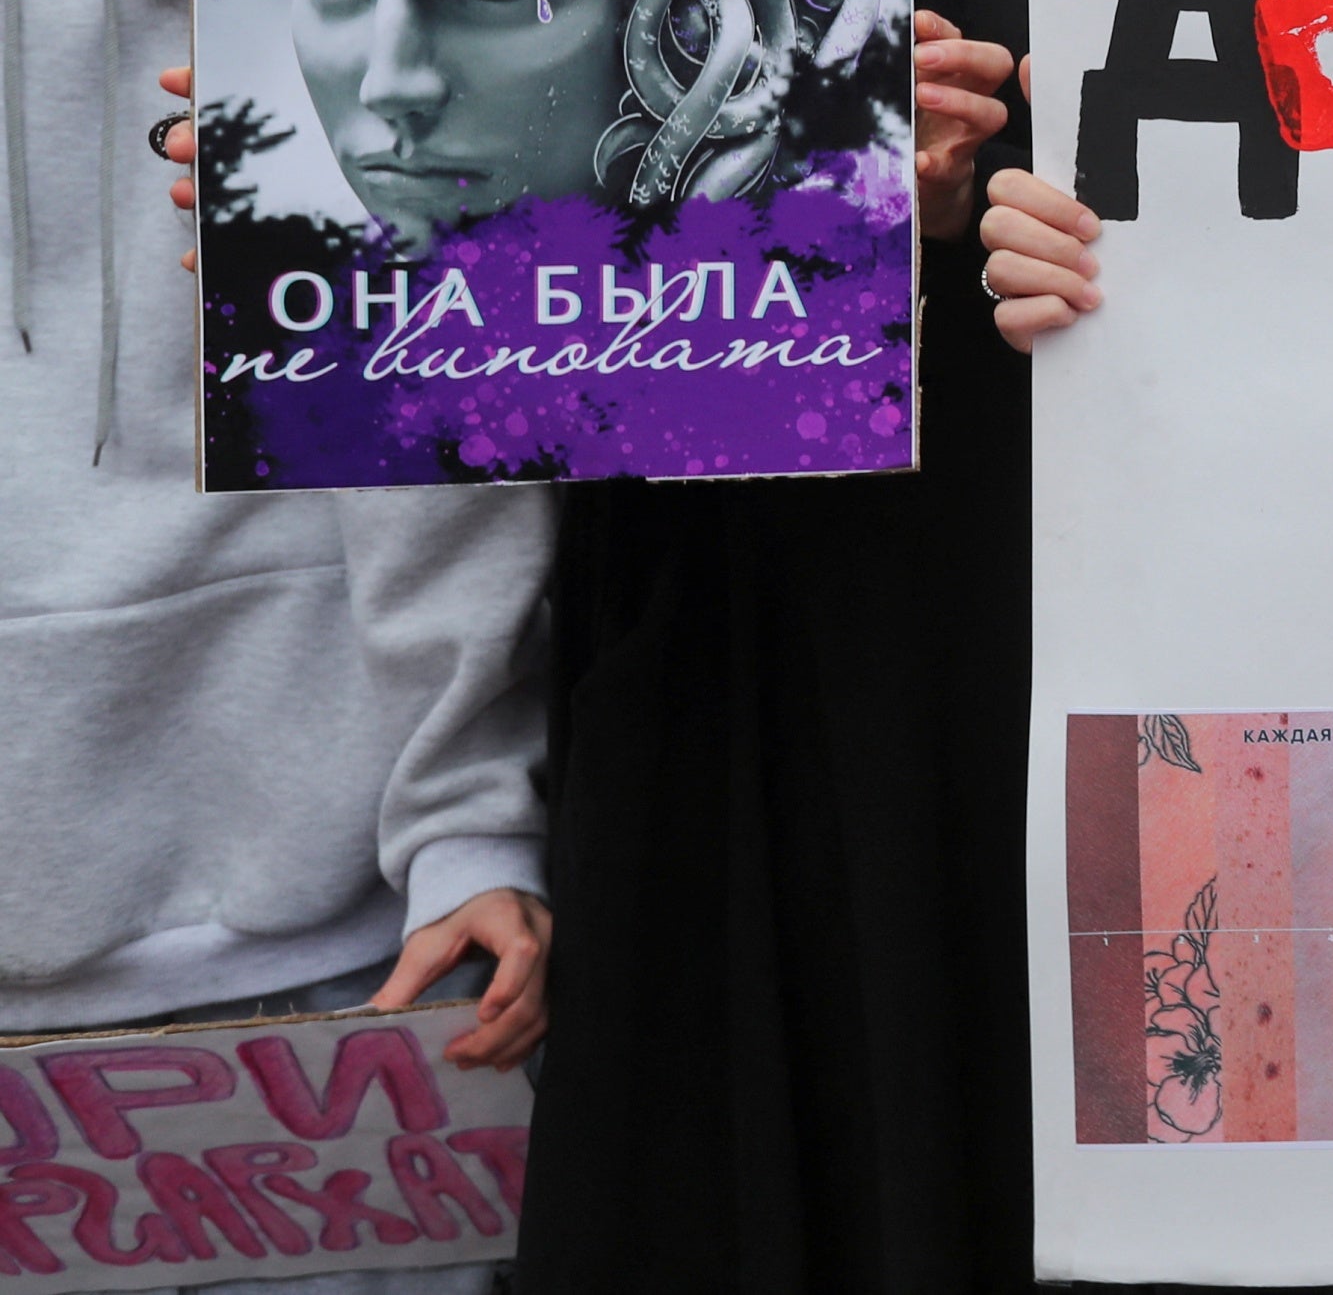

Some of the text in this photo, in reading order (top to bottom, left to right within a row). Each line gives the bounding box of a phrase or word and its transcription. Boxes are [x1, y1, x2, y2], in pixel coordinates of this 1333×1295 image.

[269, 261, 808, 332] ОНА БЫЛА
[1244, 728, 1331, 744] КАЖДАЯ
